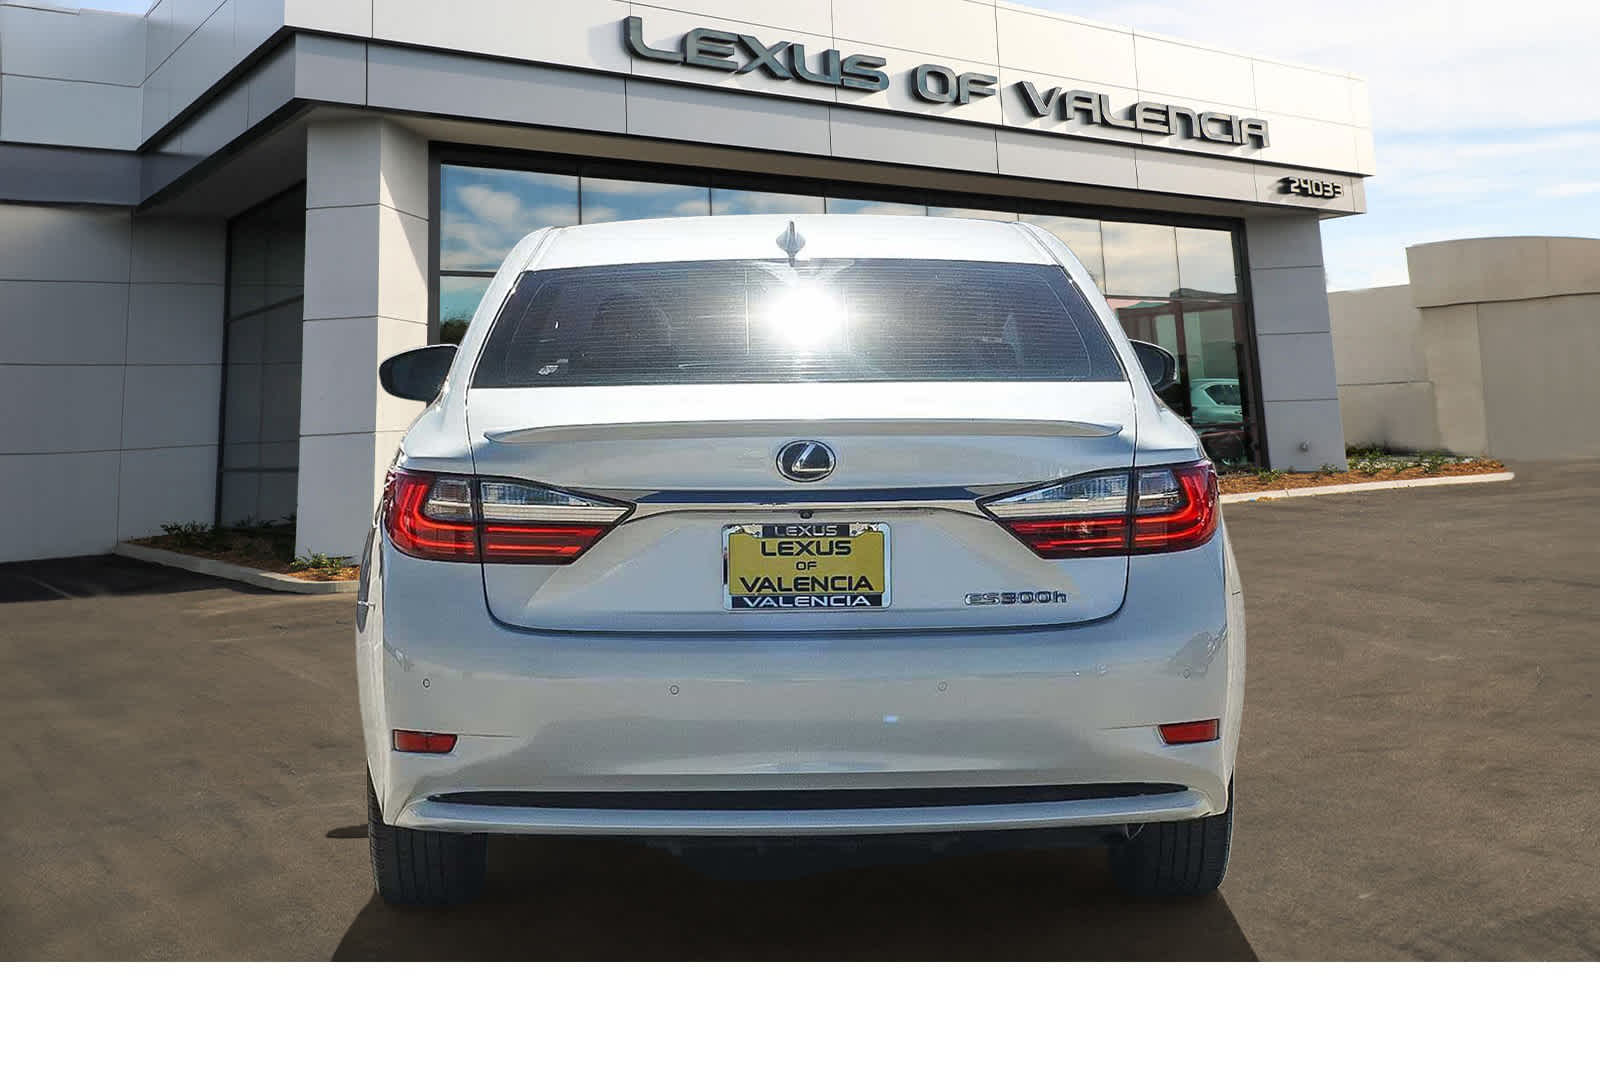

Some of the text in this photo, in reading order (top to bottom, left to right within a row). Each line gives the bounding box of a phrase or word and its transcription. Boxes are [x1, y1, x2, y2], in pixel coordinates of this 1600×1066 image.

[624, 16, 1270, 149] LEXUS OF VALENCIA
[1288, 178, 1343, 197] 24033
[775, 525, 837, 536] LEXUS
[761, 541, 852, 556] LEXUS
[796, 562, 817, 571] OF
[740, 576, 873, 592] VALENCIA
[743, 596, 871, 607] VALENCIA
